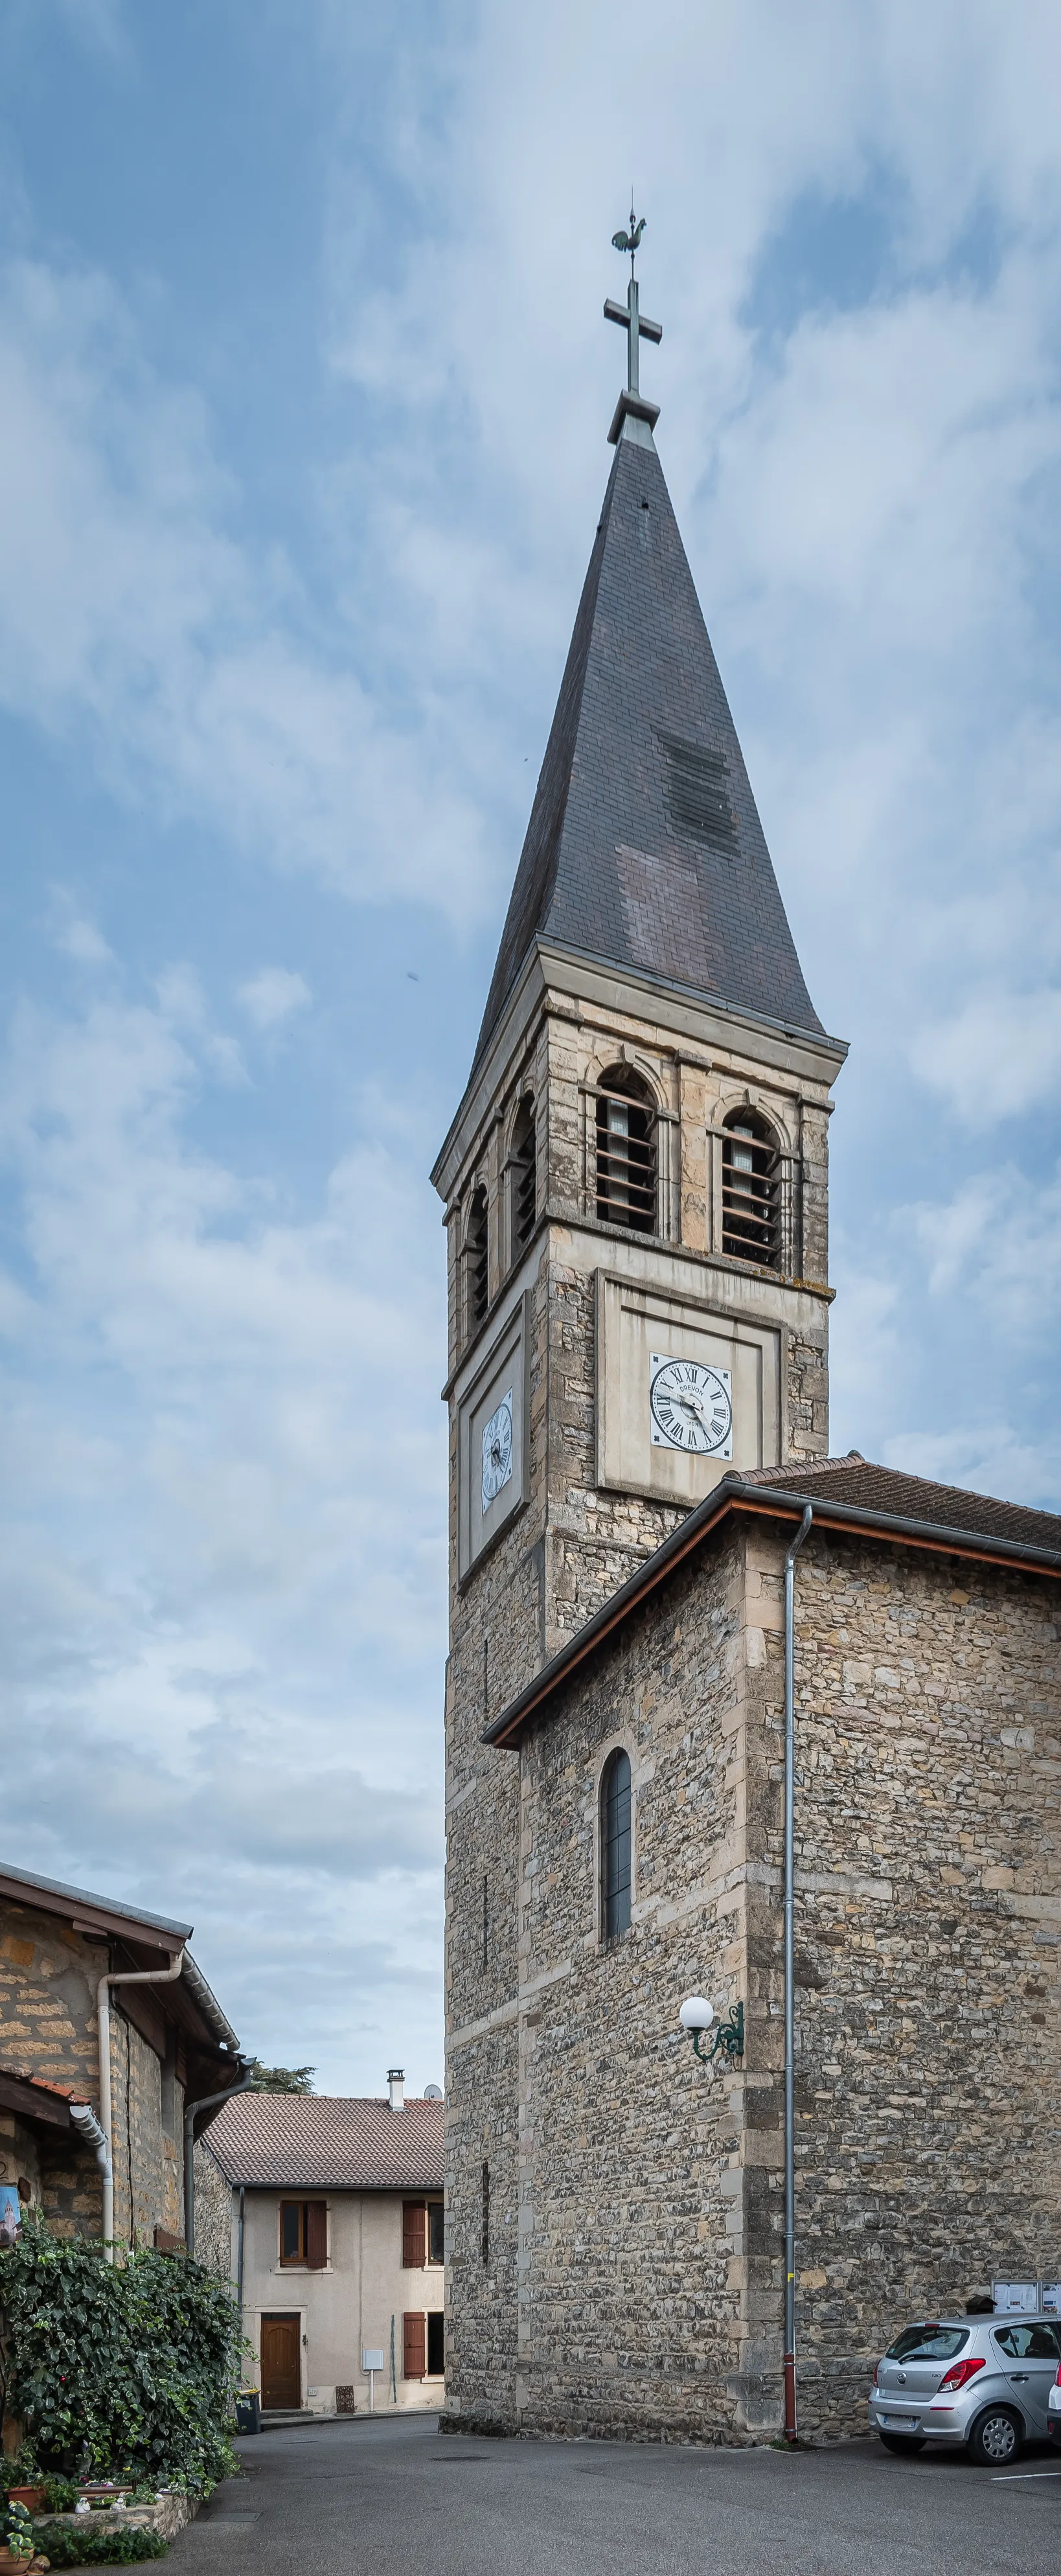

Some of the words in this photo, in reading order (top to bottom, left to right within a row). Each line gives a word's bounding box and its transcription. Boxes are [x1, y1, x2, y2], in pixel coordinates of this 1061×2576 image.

[670, 1368, 683, 1385] XI
[684, 1367, 698, 1384] XII
[702, 1376, 710, 1388] I
[660, 1377, 674, 1390] X
[679, 1385, 704, 1396] DREVON
[656, 1393, 670, 1406] IX
[710, 1390, 722, 1401] II
[659, 1408, 675, 1428] VIII
[713, 1407, 725, 1420] III
[670, 1421, 683, 1441] VII
[688, 1430, 698, 1445] VI
[703, 1429, 713, 1445] V
